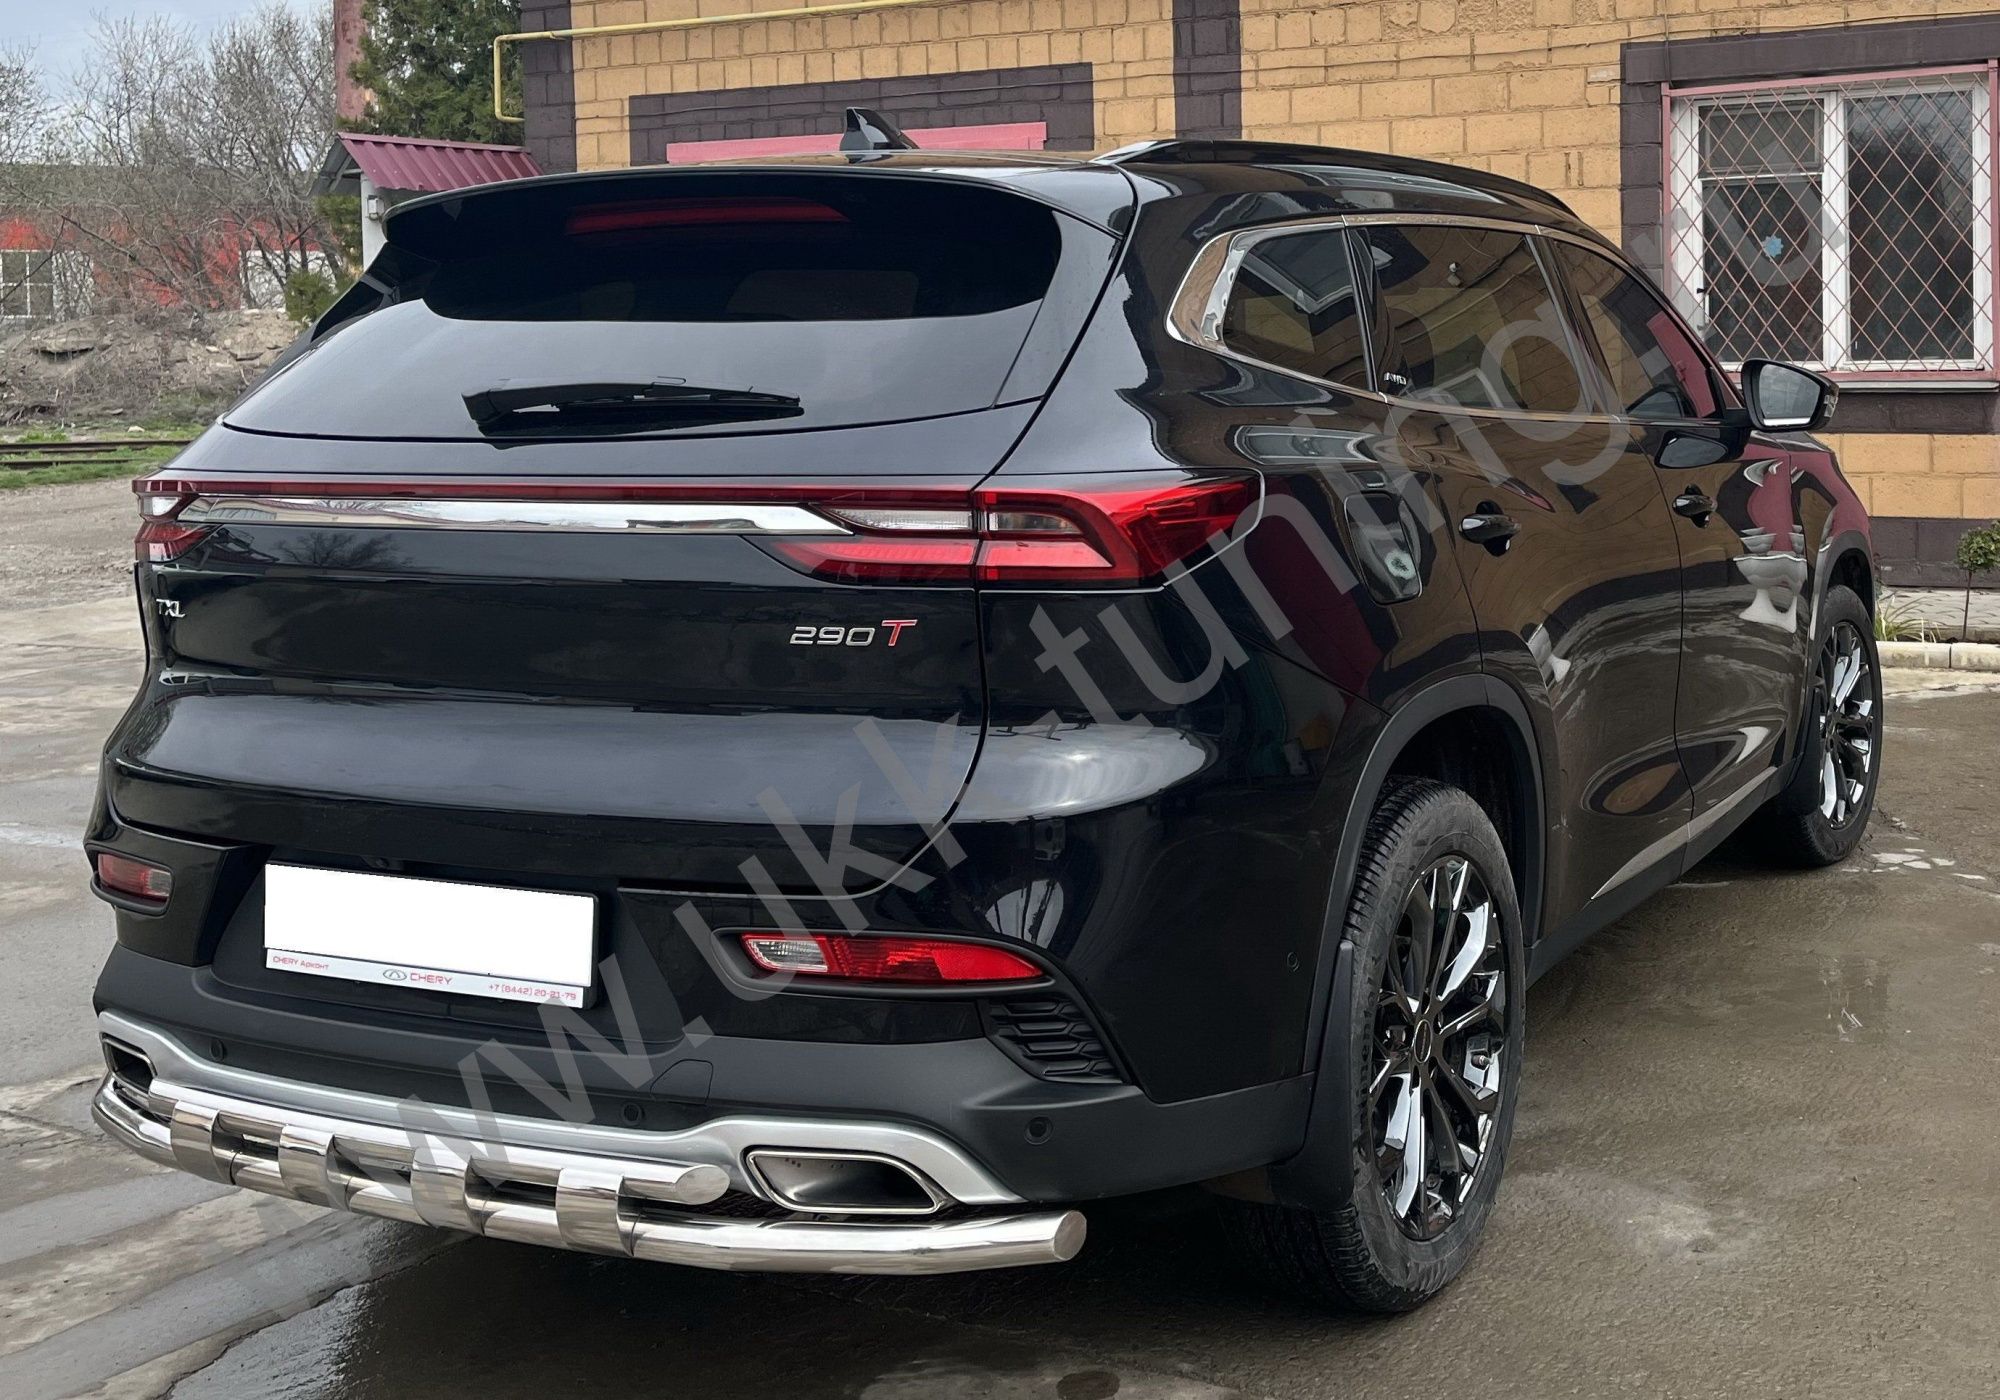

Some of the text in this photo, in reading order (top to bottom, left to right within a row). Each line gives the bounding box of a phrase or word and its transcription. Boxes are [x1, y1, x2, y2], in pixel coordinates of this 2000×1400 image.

[156, 598, 186, 618] TXL
[272, 955, 299, 965] CHERY
[410, 972, 453, 985] CHERY
[489, 984, 500, 992] +7
